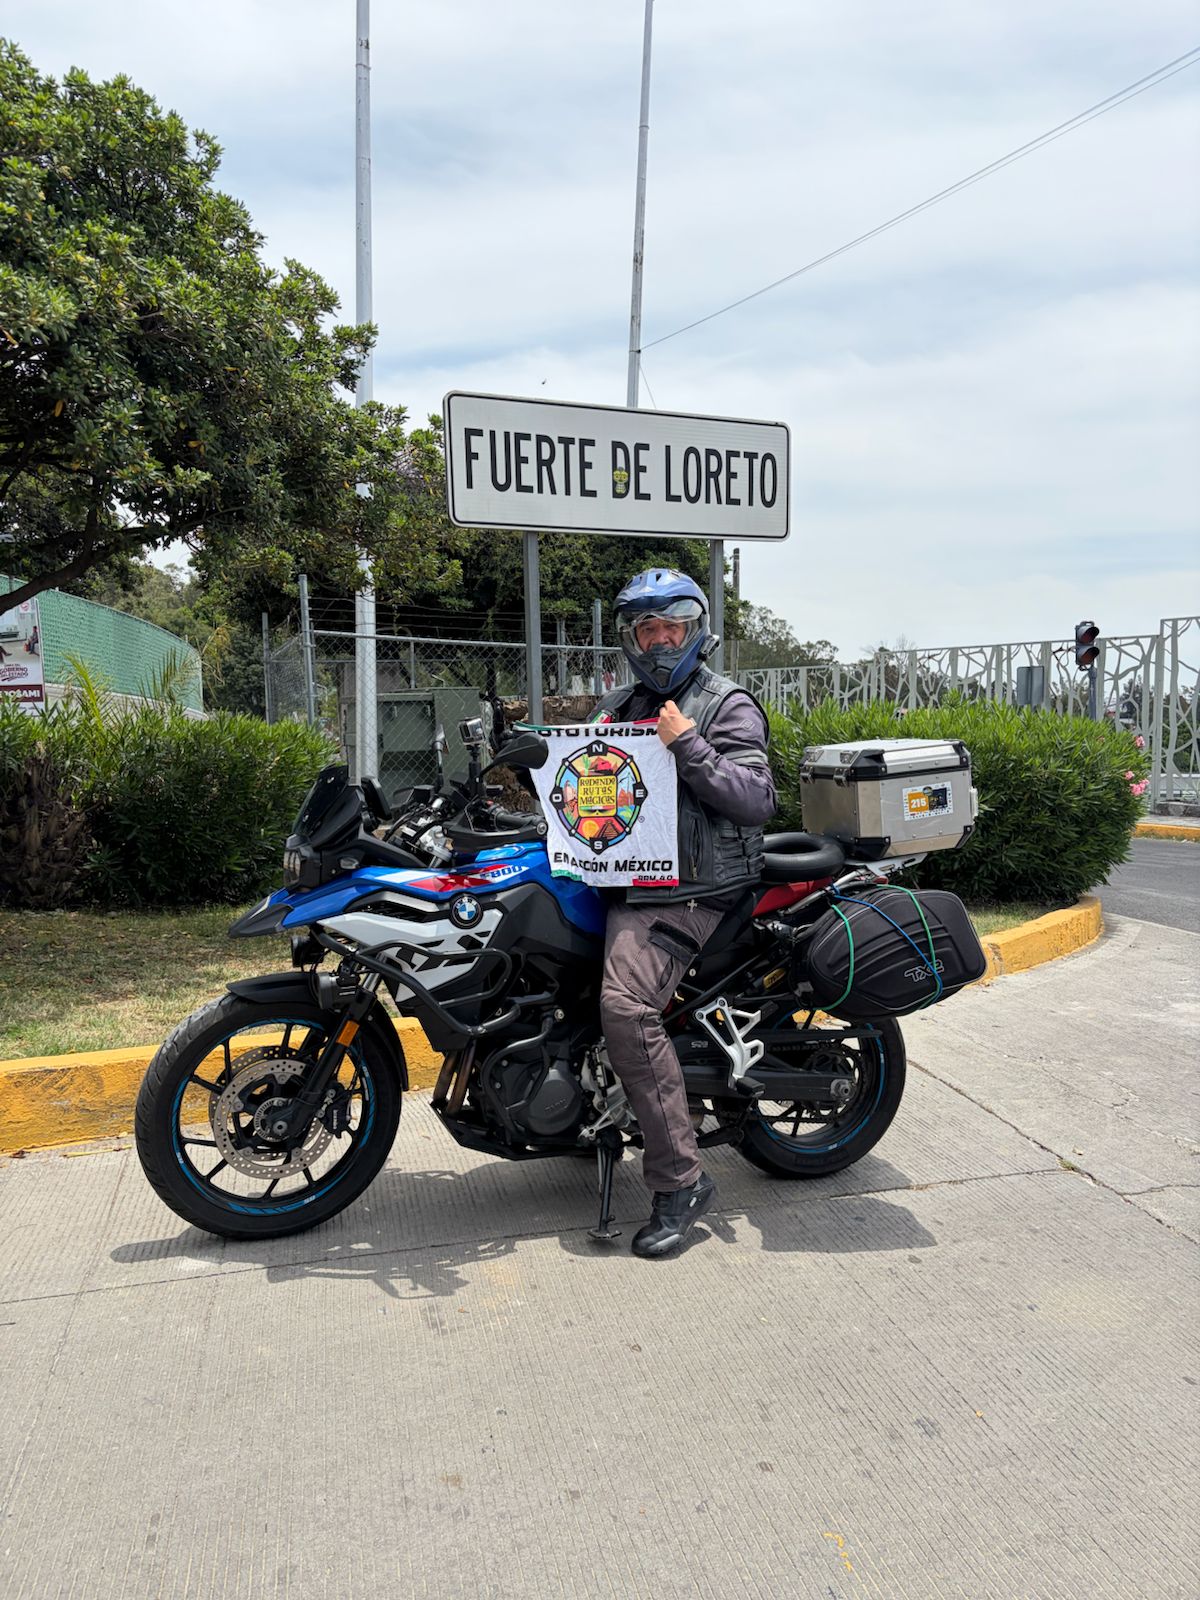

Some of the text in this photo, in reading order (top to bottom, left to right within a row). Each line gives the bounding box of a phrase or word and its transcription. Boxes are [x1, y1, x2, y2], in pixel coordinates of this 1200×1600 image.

[464, 427, 777, 508] FUERTE DE LORETO
[537, 727, 659, 737] OTOTURISM
[592, 744, 603, 752] N
[636, 789, 644, 798] E
[911, 797, 927, 809] 215
[594, 841, 602, 849] S
[614, 856, 673, 872] MÉXICO
